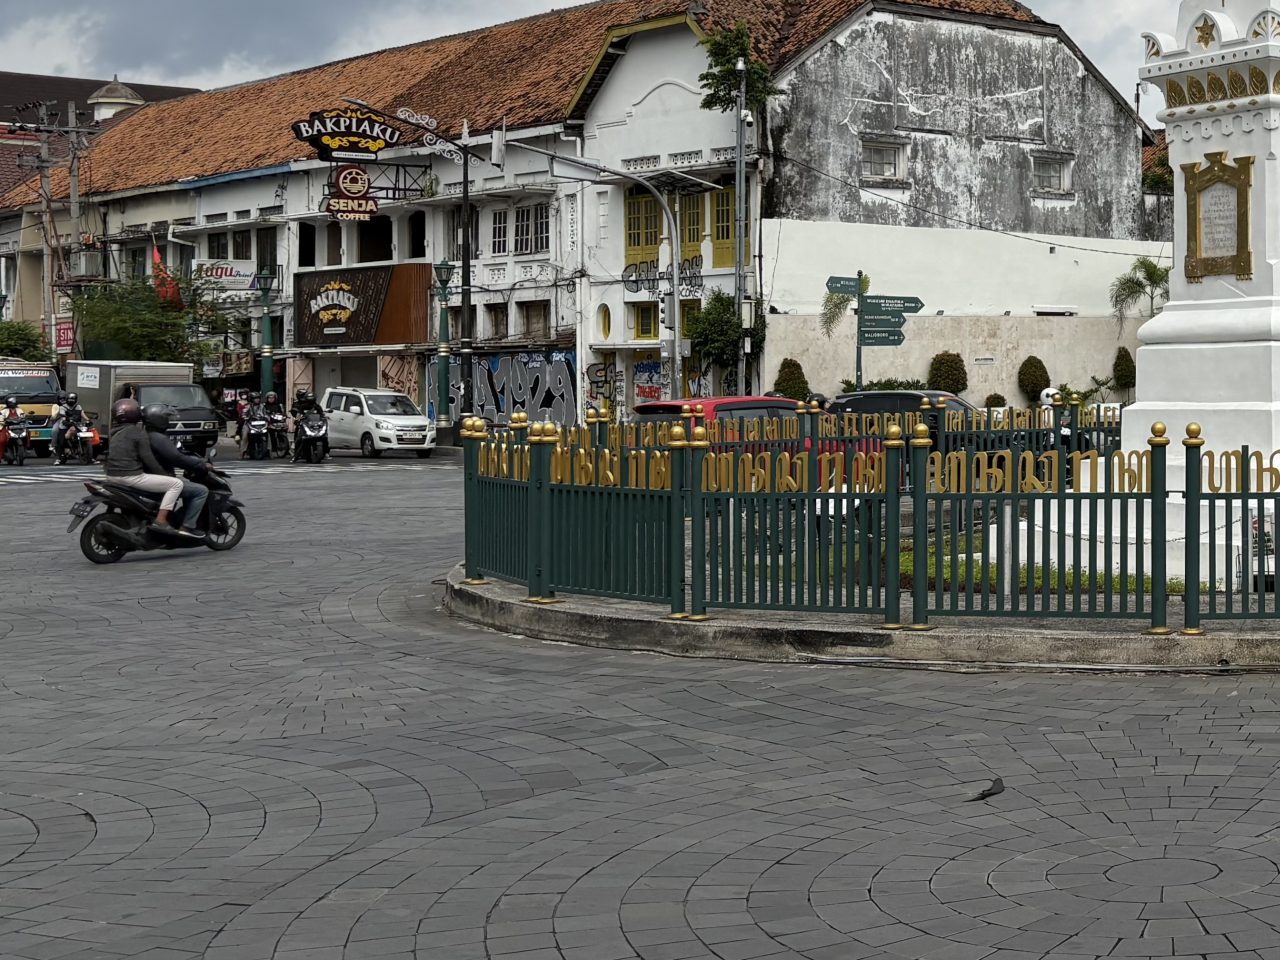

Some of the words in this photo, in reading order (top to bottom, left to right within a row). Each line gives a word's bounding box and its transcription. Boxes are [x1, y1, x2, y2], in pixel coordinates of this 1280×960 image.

[298, 117, 400, 144] BAKPIAKU
[329, 198, 378, 212] SENJA
[336, 212, 371, 221] COFFEE
[309, 290, 359, 314] BAKPIAKU
